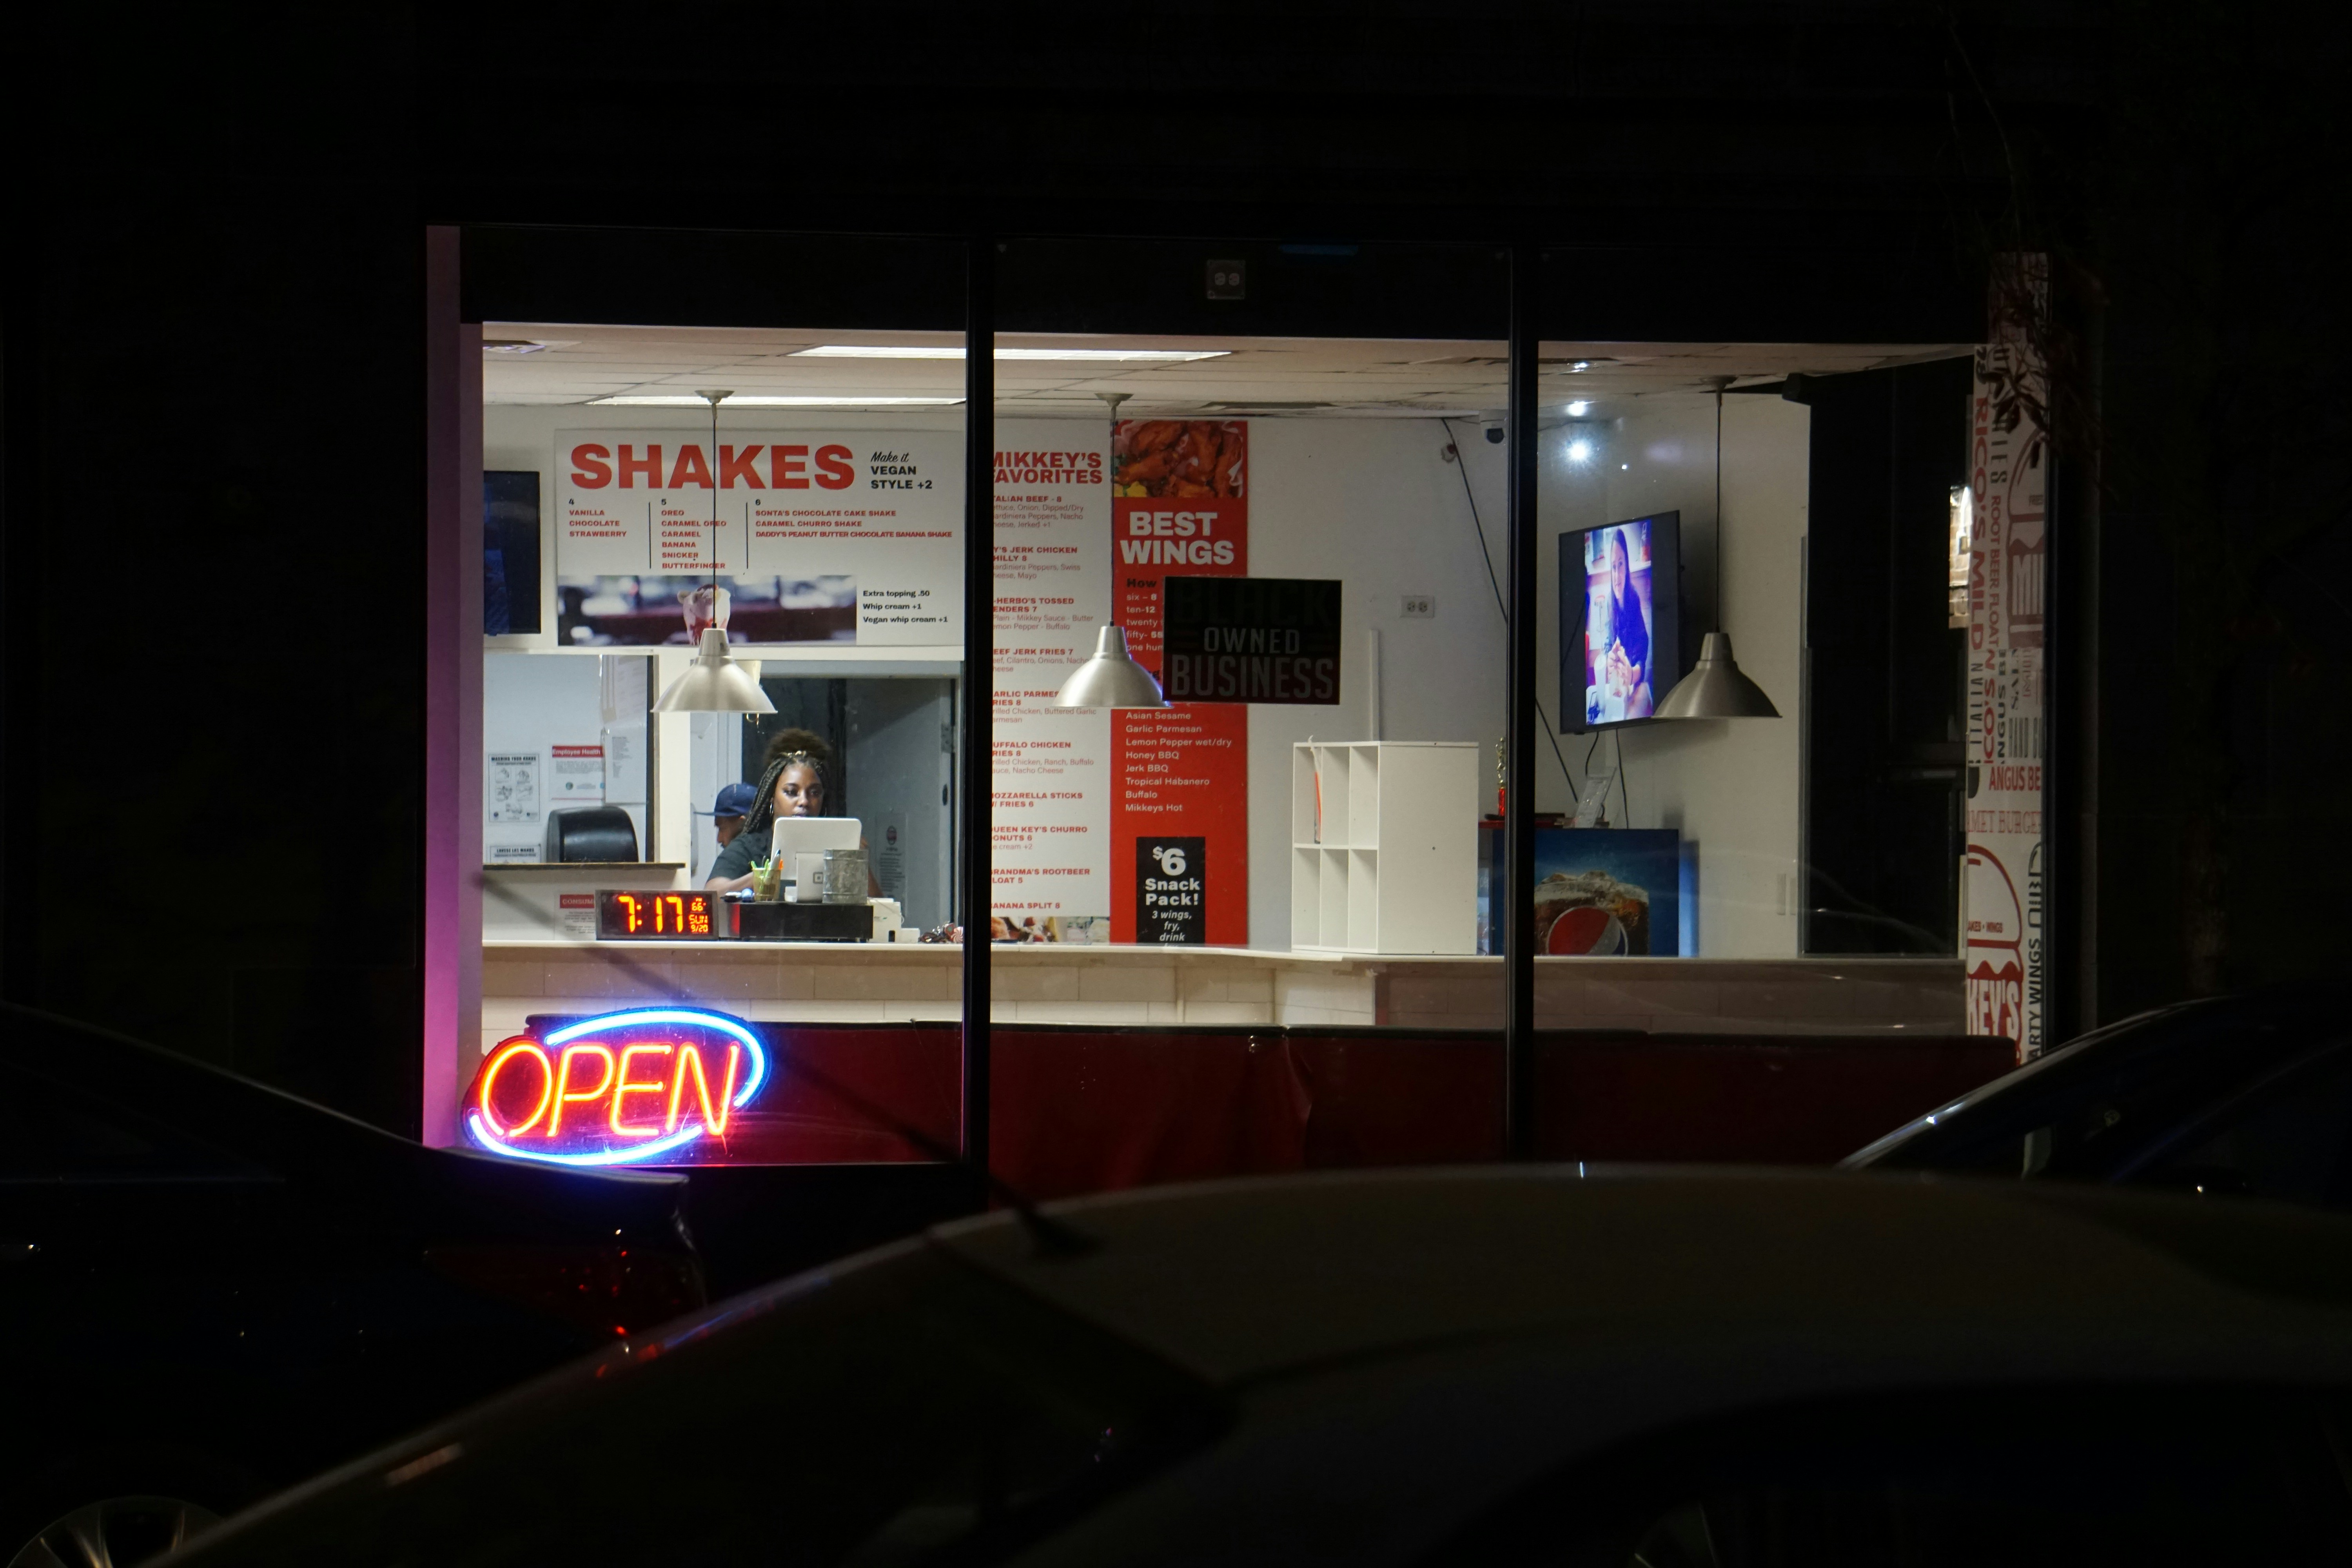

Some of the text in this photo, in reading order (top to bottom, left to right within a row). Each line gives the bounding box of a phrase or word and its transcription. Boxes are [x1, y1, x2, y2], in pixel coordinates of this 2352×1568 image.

[871, 451, 909, 462] Make it
[571, 443, 855, 490] SHAKES
[871, 466, 916, 475] VEGAN
[1973, 397, 1988, 541] RICO'S
[994, 469, 1102, 484] AVORITES
[871, 480, 932, 489] STYLE +2
[1130, 512, 1218, 536] BEST
[1991, 495, 2001, 544] ROOT
[1120, 540, 1234, 565] WINGS
[1990, 549, 2000, 590] BEER
[1127, 578, 1156, 588] How
[1971, 550, 1985, 650] MILD
[1127, 619, 1158, 627] twenty
[1989, 593, 2000, 646] FLOAT
[1127, 630, 1147, 641] fifty-
[1204, 627, 1300, 654] OWNED
[1171, 655, 1334, 699] BUSINESS
[1984, 679, 1995, 764] ICO'S
[1160, 738, 1192, 747] Pepper
[1195, 738, 1231, 748] wet/dry
[1126, 751, 1179, 760] Honey BBQ
[1147, 764, 1168, 773] BBQ
[1125, 777, 1162, 787] Tropical
[1989, 766, 2025, 791] ANGUS
[1153, 846, 1186, 876] $6
[1145, 878, 1200, 891] Snack
[1146, 893, 1198, 905] Pack!
[617, 895, 683, 933] 7:17
[689, 915, 708, 924] SUN
[1161, 910, 1192, 920] wings,
[691, 924, 708, 933] 9/20
[1164, 921, 1179, 932] fry,
[1160, 933, 1185, 941] drink
[2028, 938, 2042, 1058] ARTY WINGS
[480, 1040, 740, 1137] OPEN
